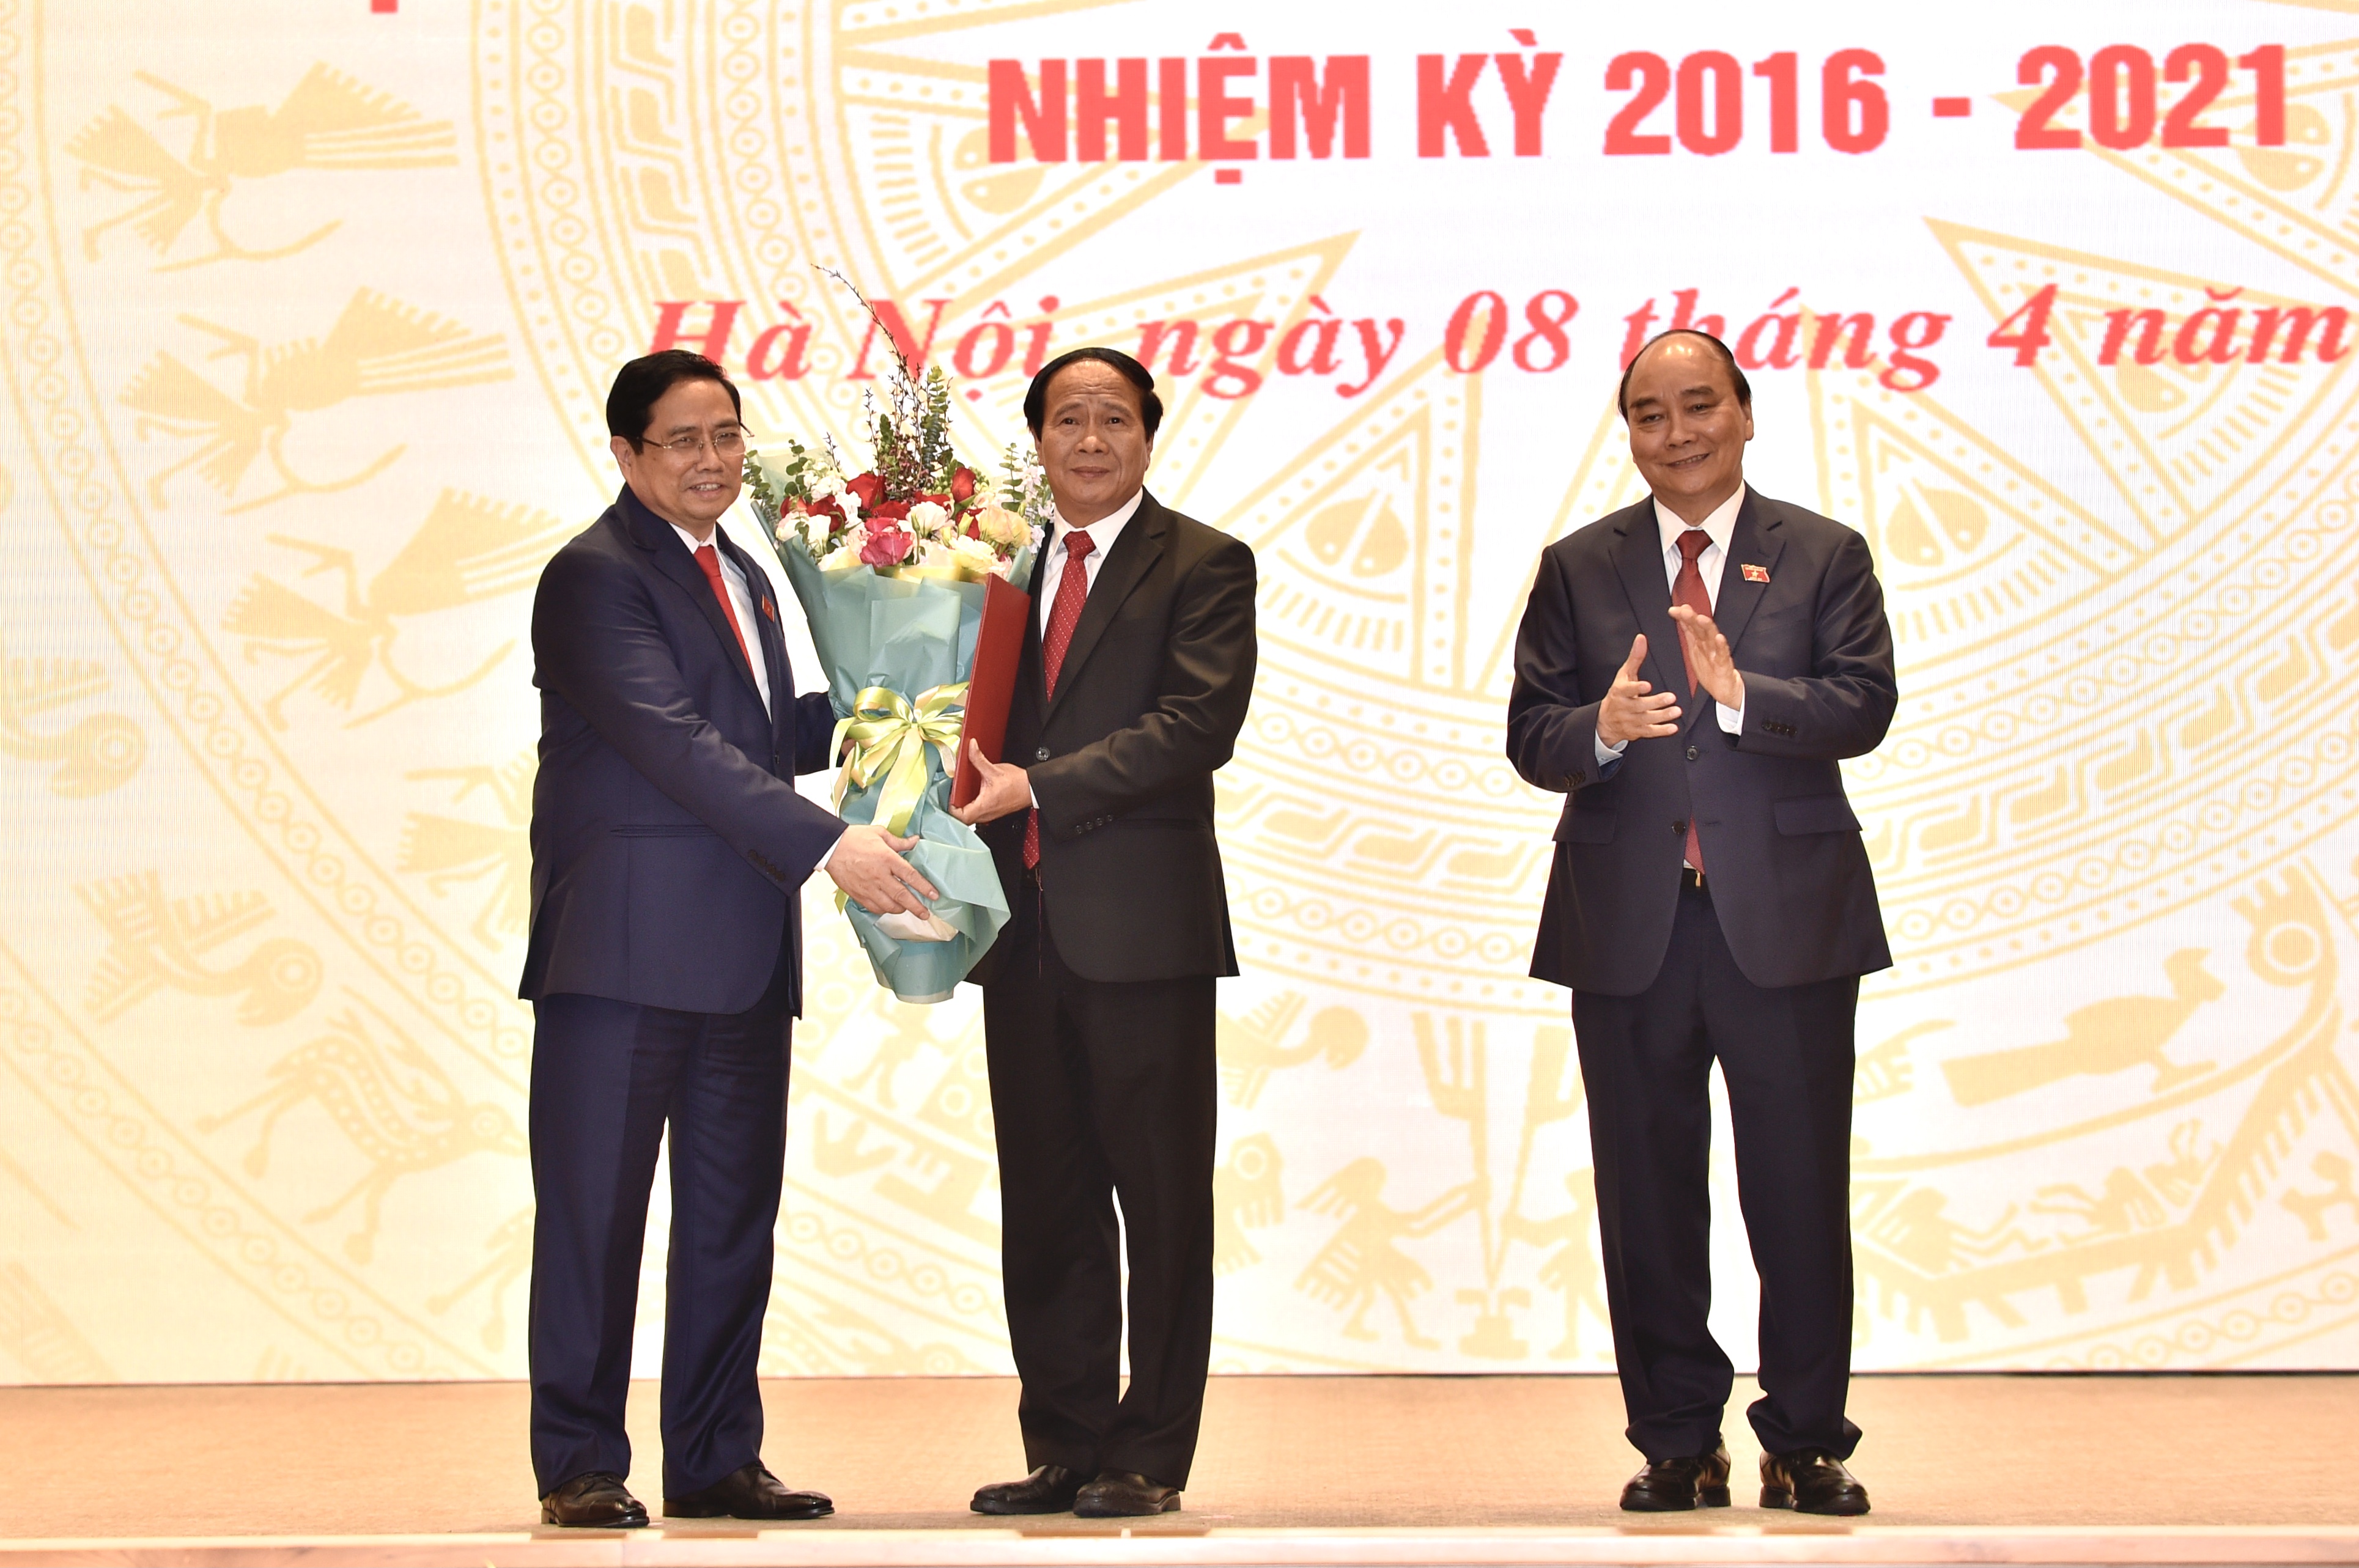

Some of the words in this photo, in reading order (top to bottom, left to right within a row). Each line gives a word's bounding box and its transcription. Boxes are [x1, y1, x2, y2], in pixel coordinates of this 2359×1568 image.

[987, 32, 1371, 185] NHIỆM
[1416, 28, 1564, 158] KỲ
[1603, 48, 1890, 157] 2016
[1932, 96, 1971, 118] -
[2014, 42, 2287, 151] 2021
[649, 300, 812, 381] Hà
[846, 295, 1060, 402] Nội
[1134, 293, 1405, 400] ngày
[1443, 289, 1579, 375] 08
[1987, 283, 2058, 368] 4
[2097, 285, 2351, 367] năm
